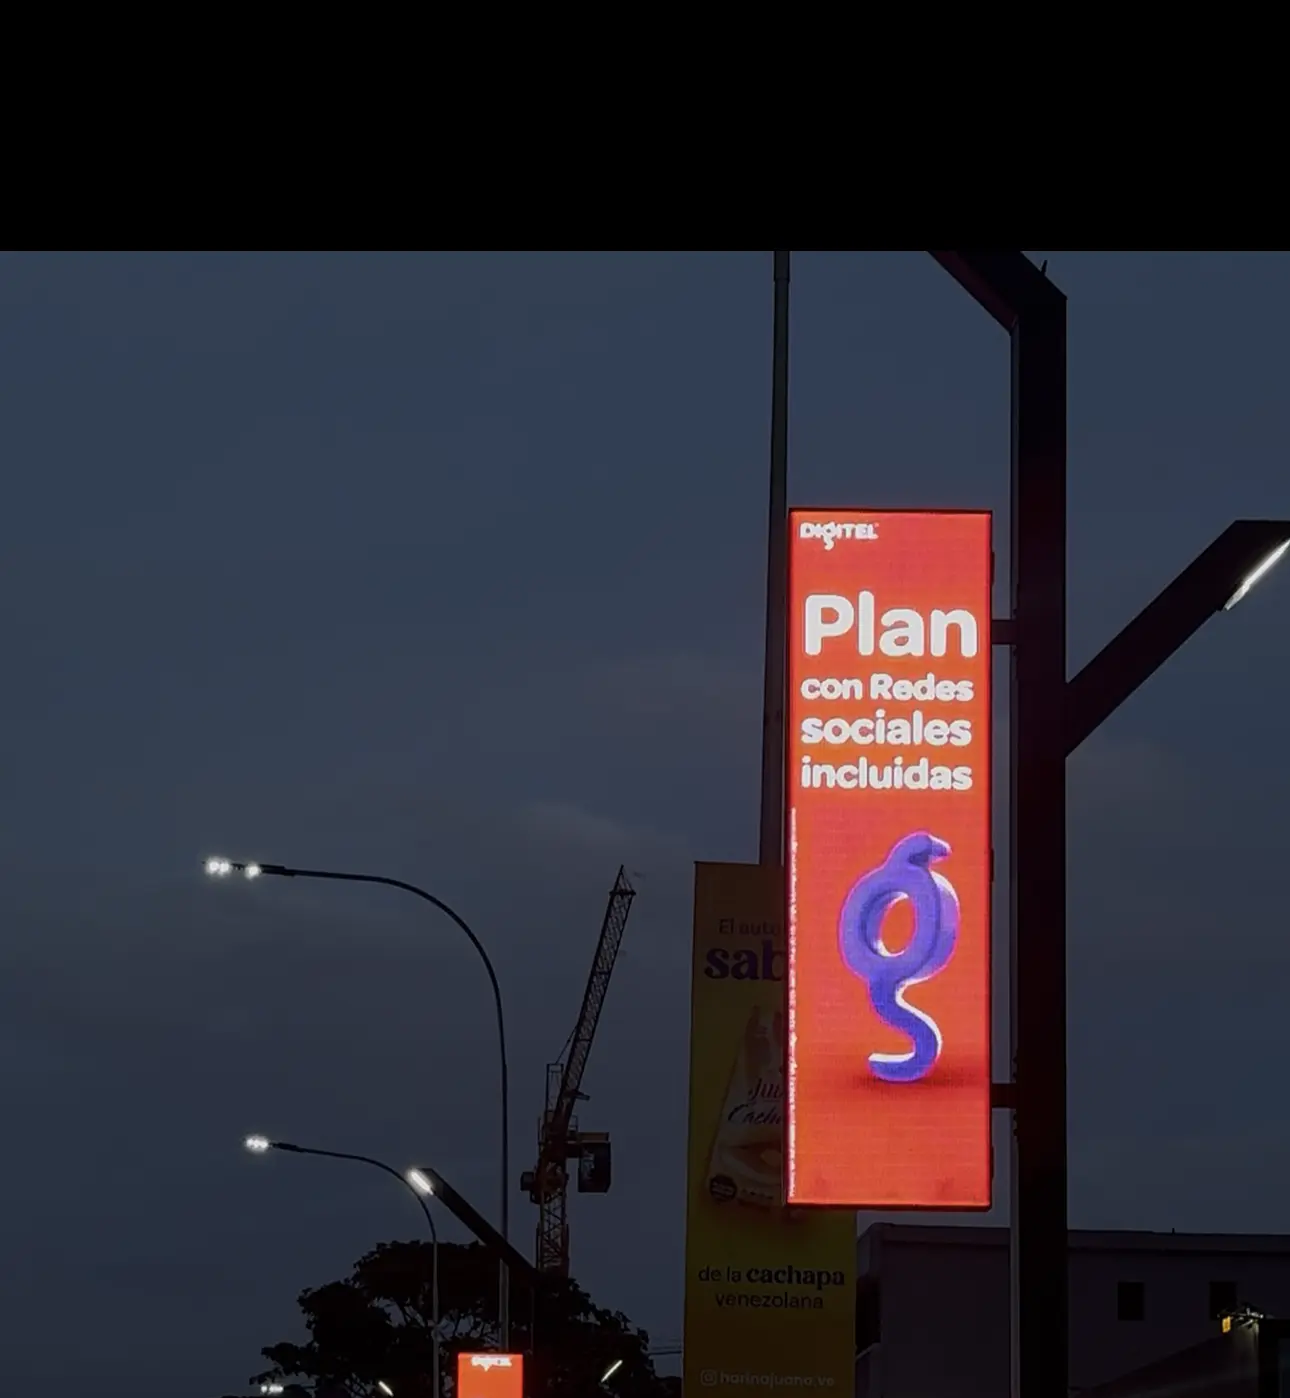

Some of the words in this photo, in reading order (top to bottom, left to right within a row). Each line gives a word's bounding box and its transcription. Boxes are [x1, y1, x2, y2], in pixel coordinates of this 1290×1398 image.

[805, 590, 978, 658] Plan
[800, 677, 864, 701] con
[869, 671, 975, 702] Redes
[800, 708, 973, 747] sociales
[801, 754, 974, 791] incluidas
[718, 917, 735, 934] El
[698, 1264, 723, 1282] de
[726, 1266, 742, 1283] la
[746, 1264, 846, 1290] cachapa
[714, 1291, 824, 1309] venezolana
